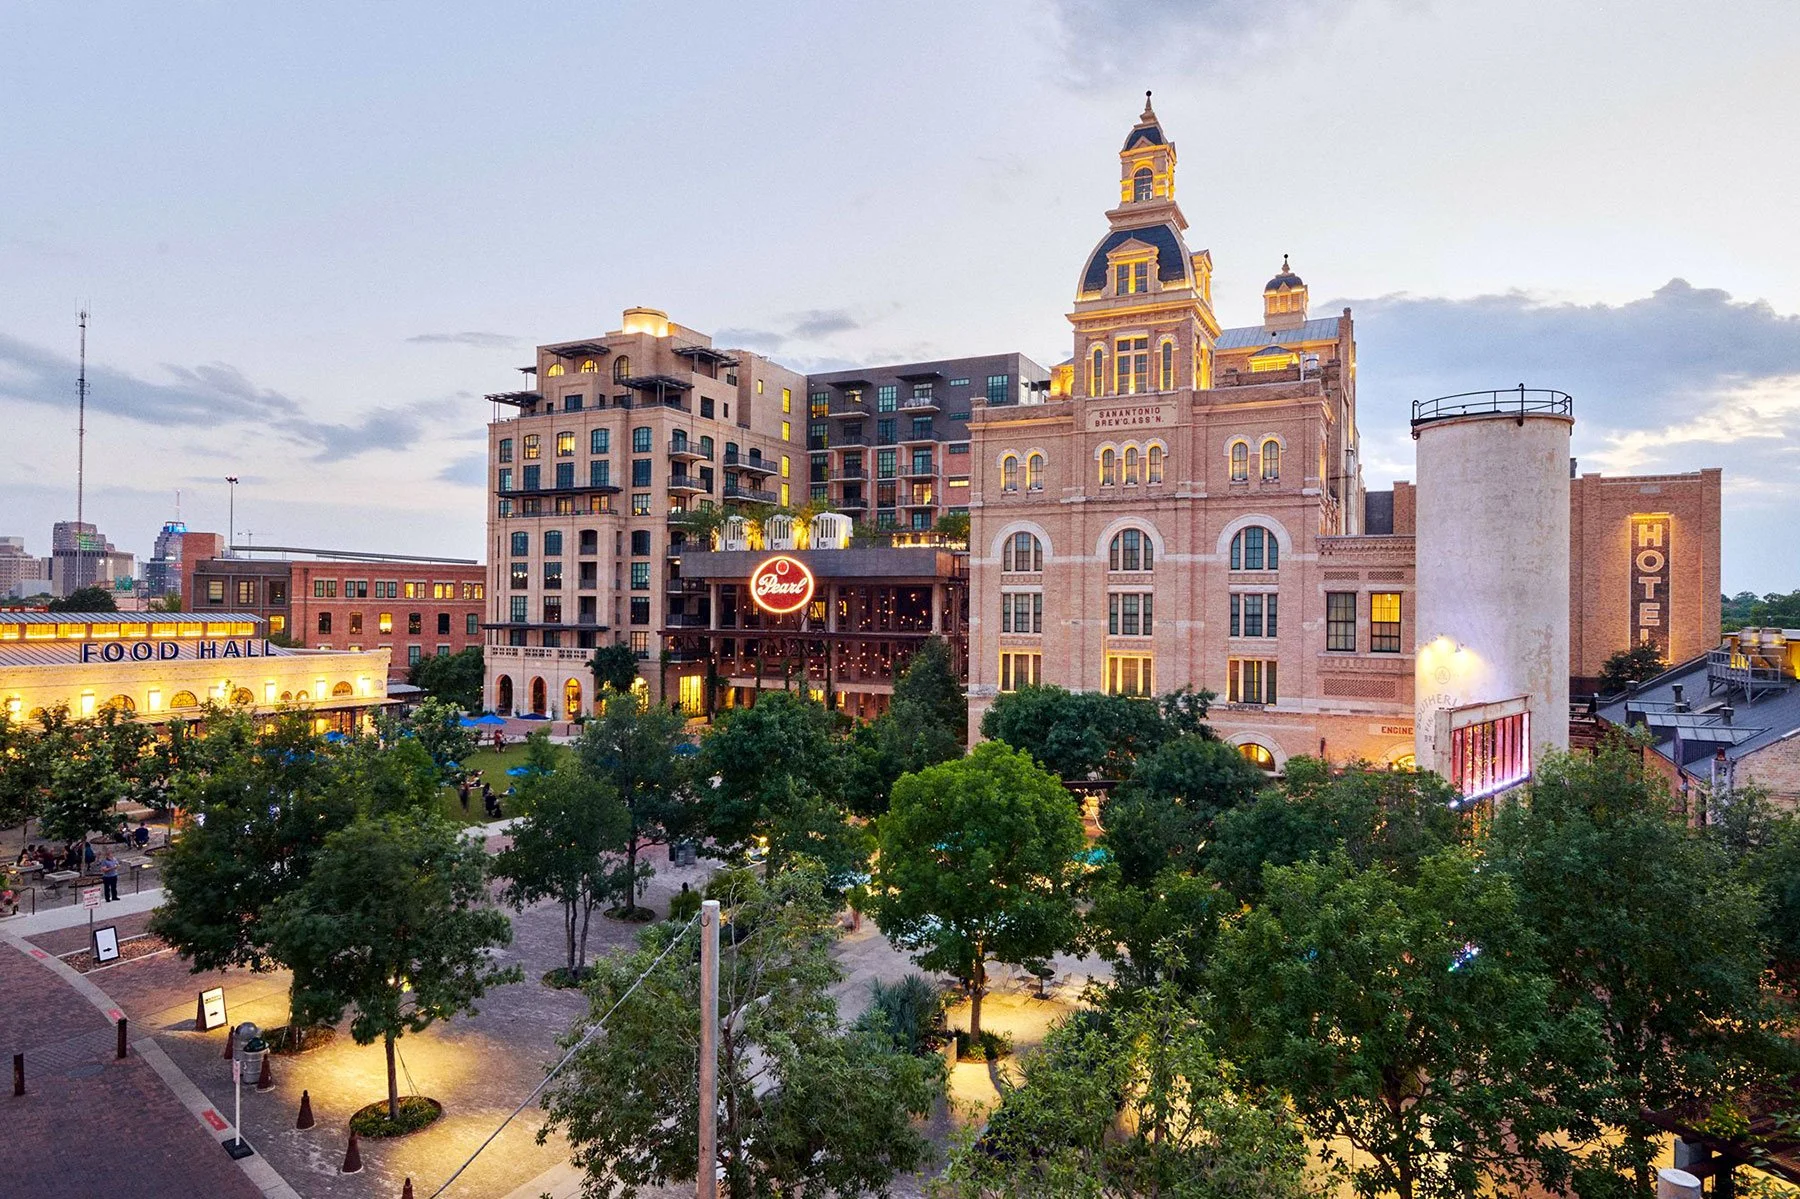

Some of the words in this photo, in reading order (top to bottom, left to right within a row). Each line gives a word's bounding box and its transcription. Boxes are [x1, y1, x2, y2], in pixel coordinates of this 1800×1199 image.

[757, 573, 808, 596] Pearl
[81, 641, 180, 663] FOOD
[199, 639, 277, 660] HALL
[1381, 726, 1414, 735] ENGINE
